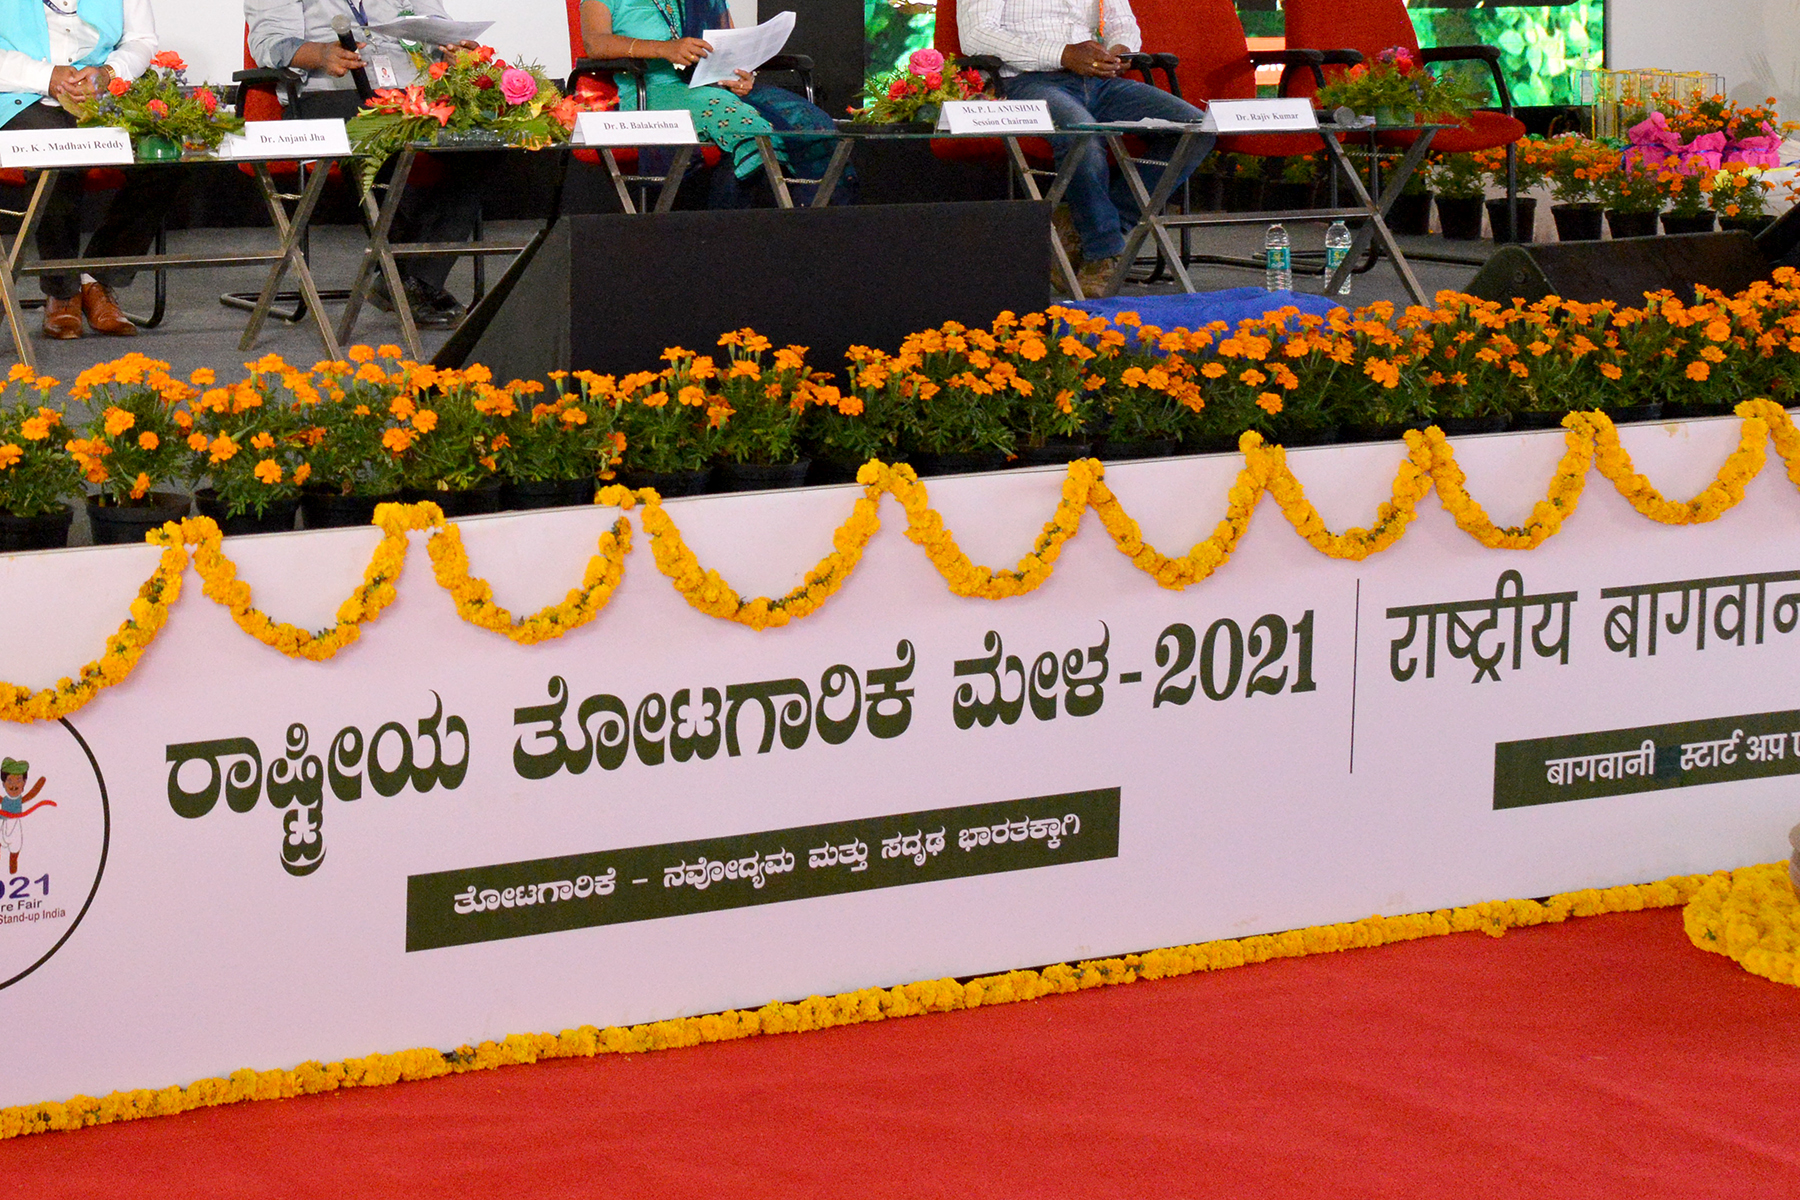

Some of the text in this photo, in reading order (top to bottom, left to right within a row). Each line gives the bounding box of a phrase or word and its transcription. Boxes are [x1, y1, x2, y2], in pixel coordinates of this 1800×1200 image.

[997, 104, 1041, 114] ANUSHMA
[972, 117, 1039, 127] Session Chairman
[1235, 112, 1299, 122] Dr. Rajiv Kumar
[603, 120, 679, 130] Dr. B. Balakrishna
[259, 133, 326, 146] Dr. Anjani Jha
[11, 144, 29, 154] Dr.
[48, 140, 92, 152] Madhavi
[94, 139, 125, 151] Reddy
[1385, 568, 1579, 685] राष्ट्रीय
[164, 688, 470, 877] ರಾಷ್ಟ್ರೀಯ
[512, 638, 916, 781] ತೋಟಗಾರಿಕೆ
[1544, 740, 1656, 787] बागवानी
[1680, 729, 1744, 771] स्टार्ट
[453, 813, 1080, 917] ತೋಟಗಾರಿಕೆ ನವೋದ್ಯಮ ಮತ್ತು ಸದೃಢ ಭಾರತಕ್ಕಾಗಿ
[17, 898, 43, 911] Fair
[42, 907, 66, 920] India
